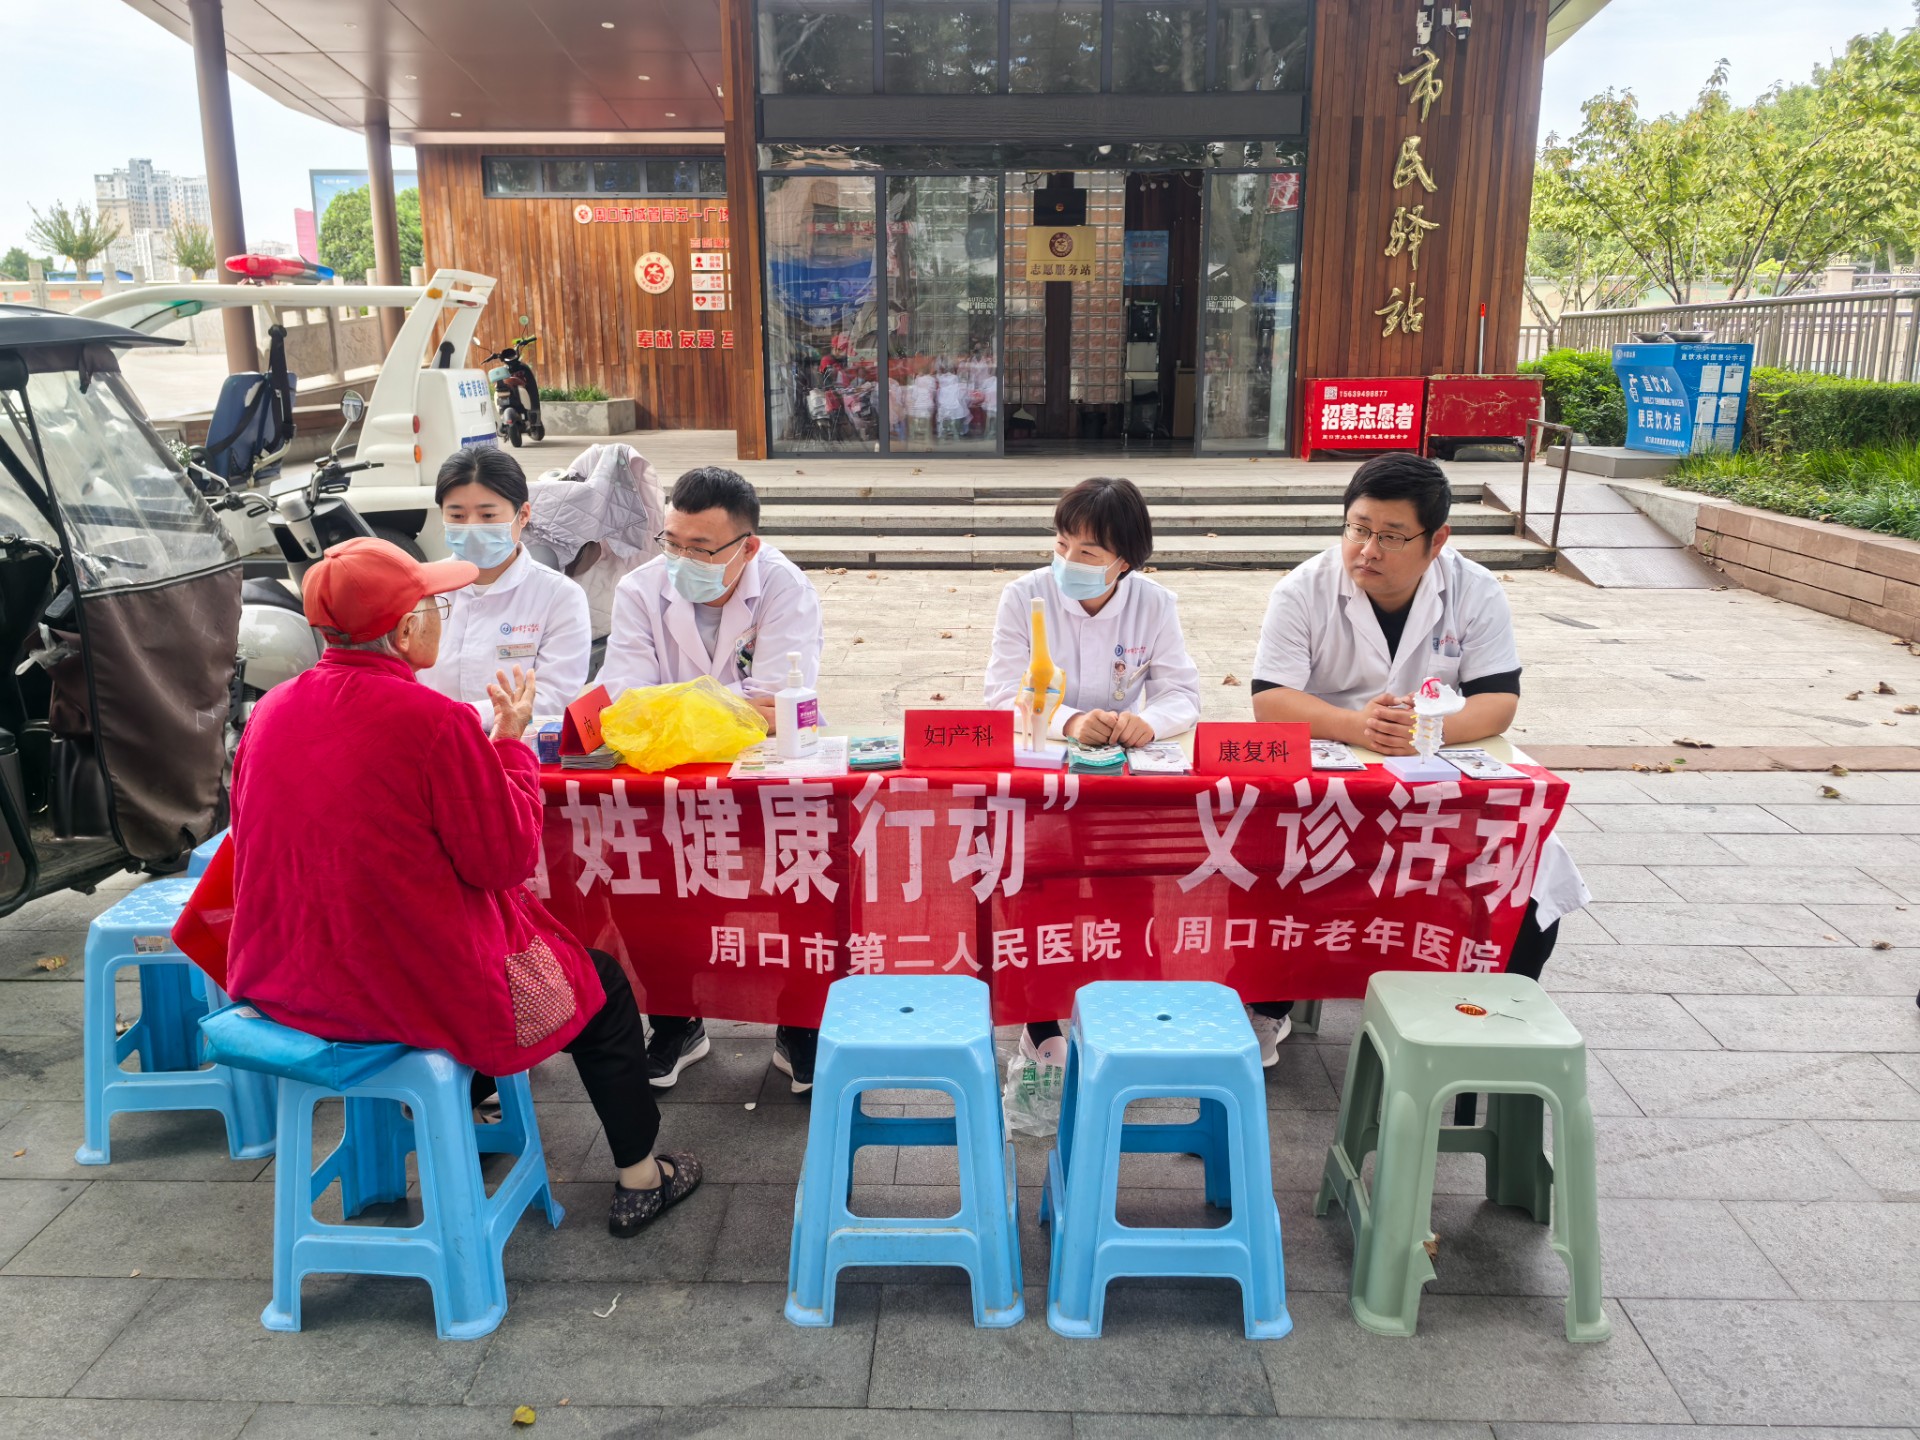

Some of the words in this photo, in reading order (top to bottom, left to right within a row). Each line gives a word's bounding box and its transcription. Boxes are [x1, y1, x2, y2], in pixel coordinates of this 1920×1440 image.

[1030, 264, 1091, 276] 志愿服务站
[636, 330, 673, 348] 奉献
[678, 330, 715, 348] 友爱
[1641, 374, 1673, 393] 直饮水
[1321, 402, 1415, 431] 招募志愿者
[1638, 409, 1682, 432] 便民饮水点
[924, 724, 994, 748] 妇产科
[1218, 739, 1290, 764] 康复科
[525, 773, 1080, 904] 姓健康行动”
[1177, 775, 1554, 915] 义诊活动
